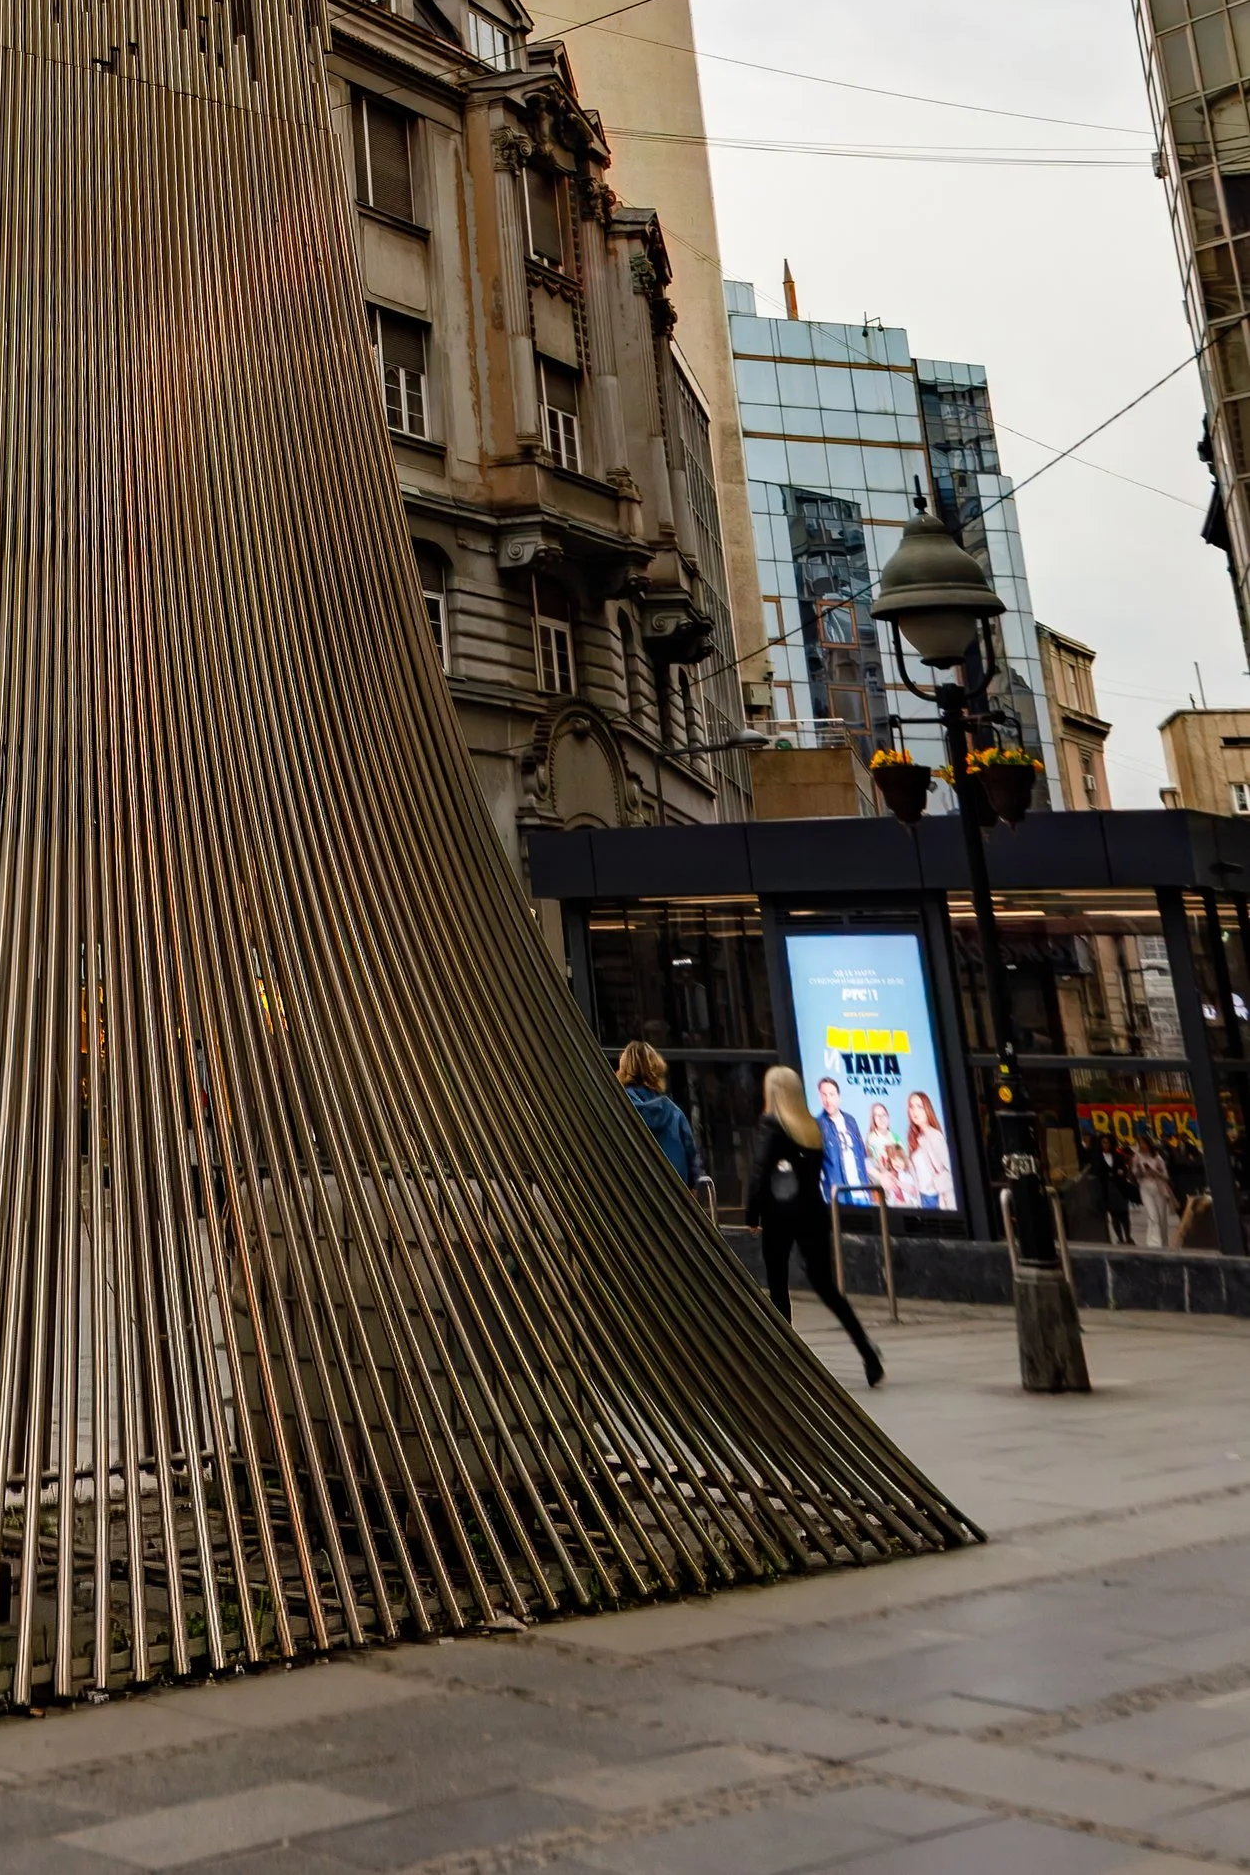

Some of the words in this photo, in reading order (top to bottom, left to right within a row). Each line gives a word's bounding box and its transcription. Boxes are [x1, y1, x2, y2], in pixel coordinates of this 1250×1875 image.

[840, 1053, 901, 1075] ТАТА
[846, 1076, 862, 1085] СЕ
[863, 1076, 902, 1086] ИГРАЈУ
[862, 1086, 889, 1097] РАТА
